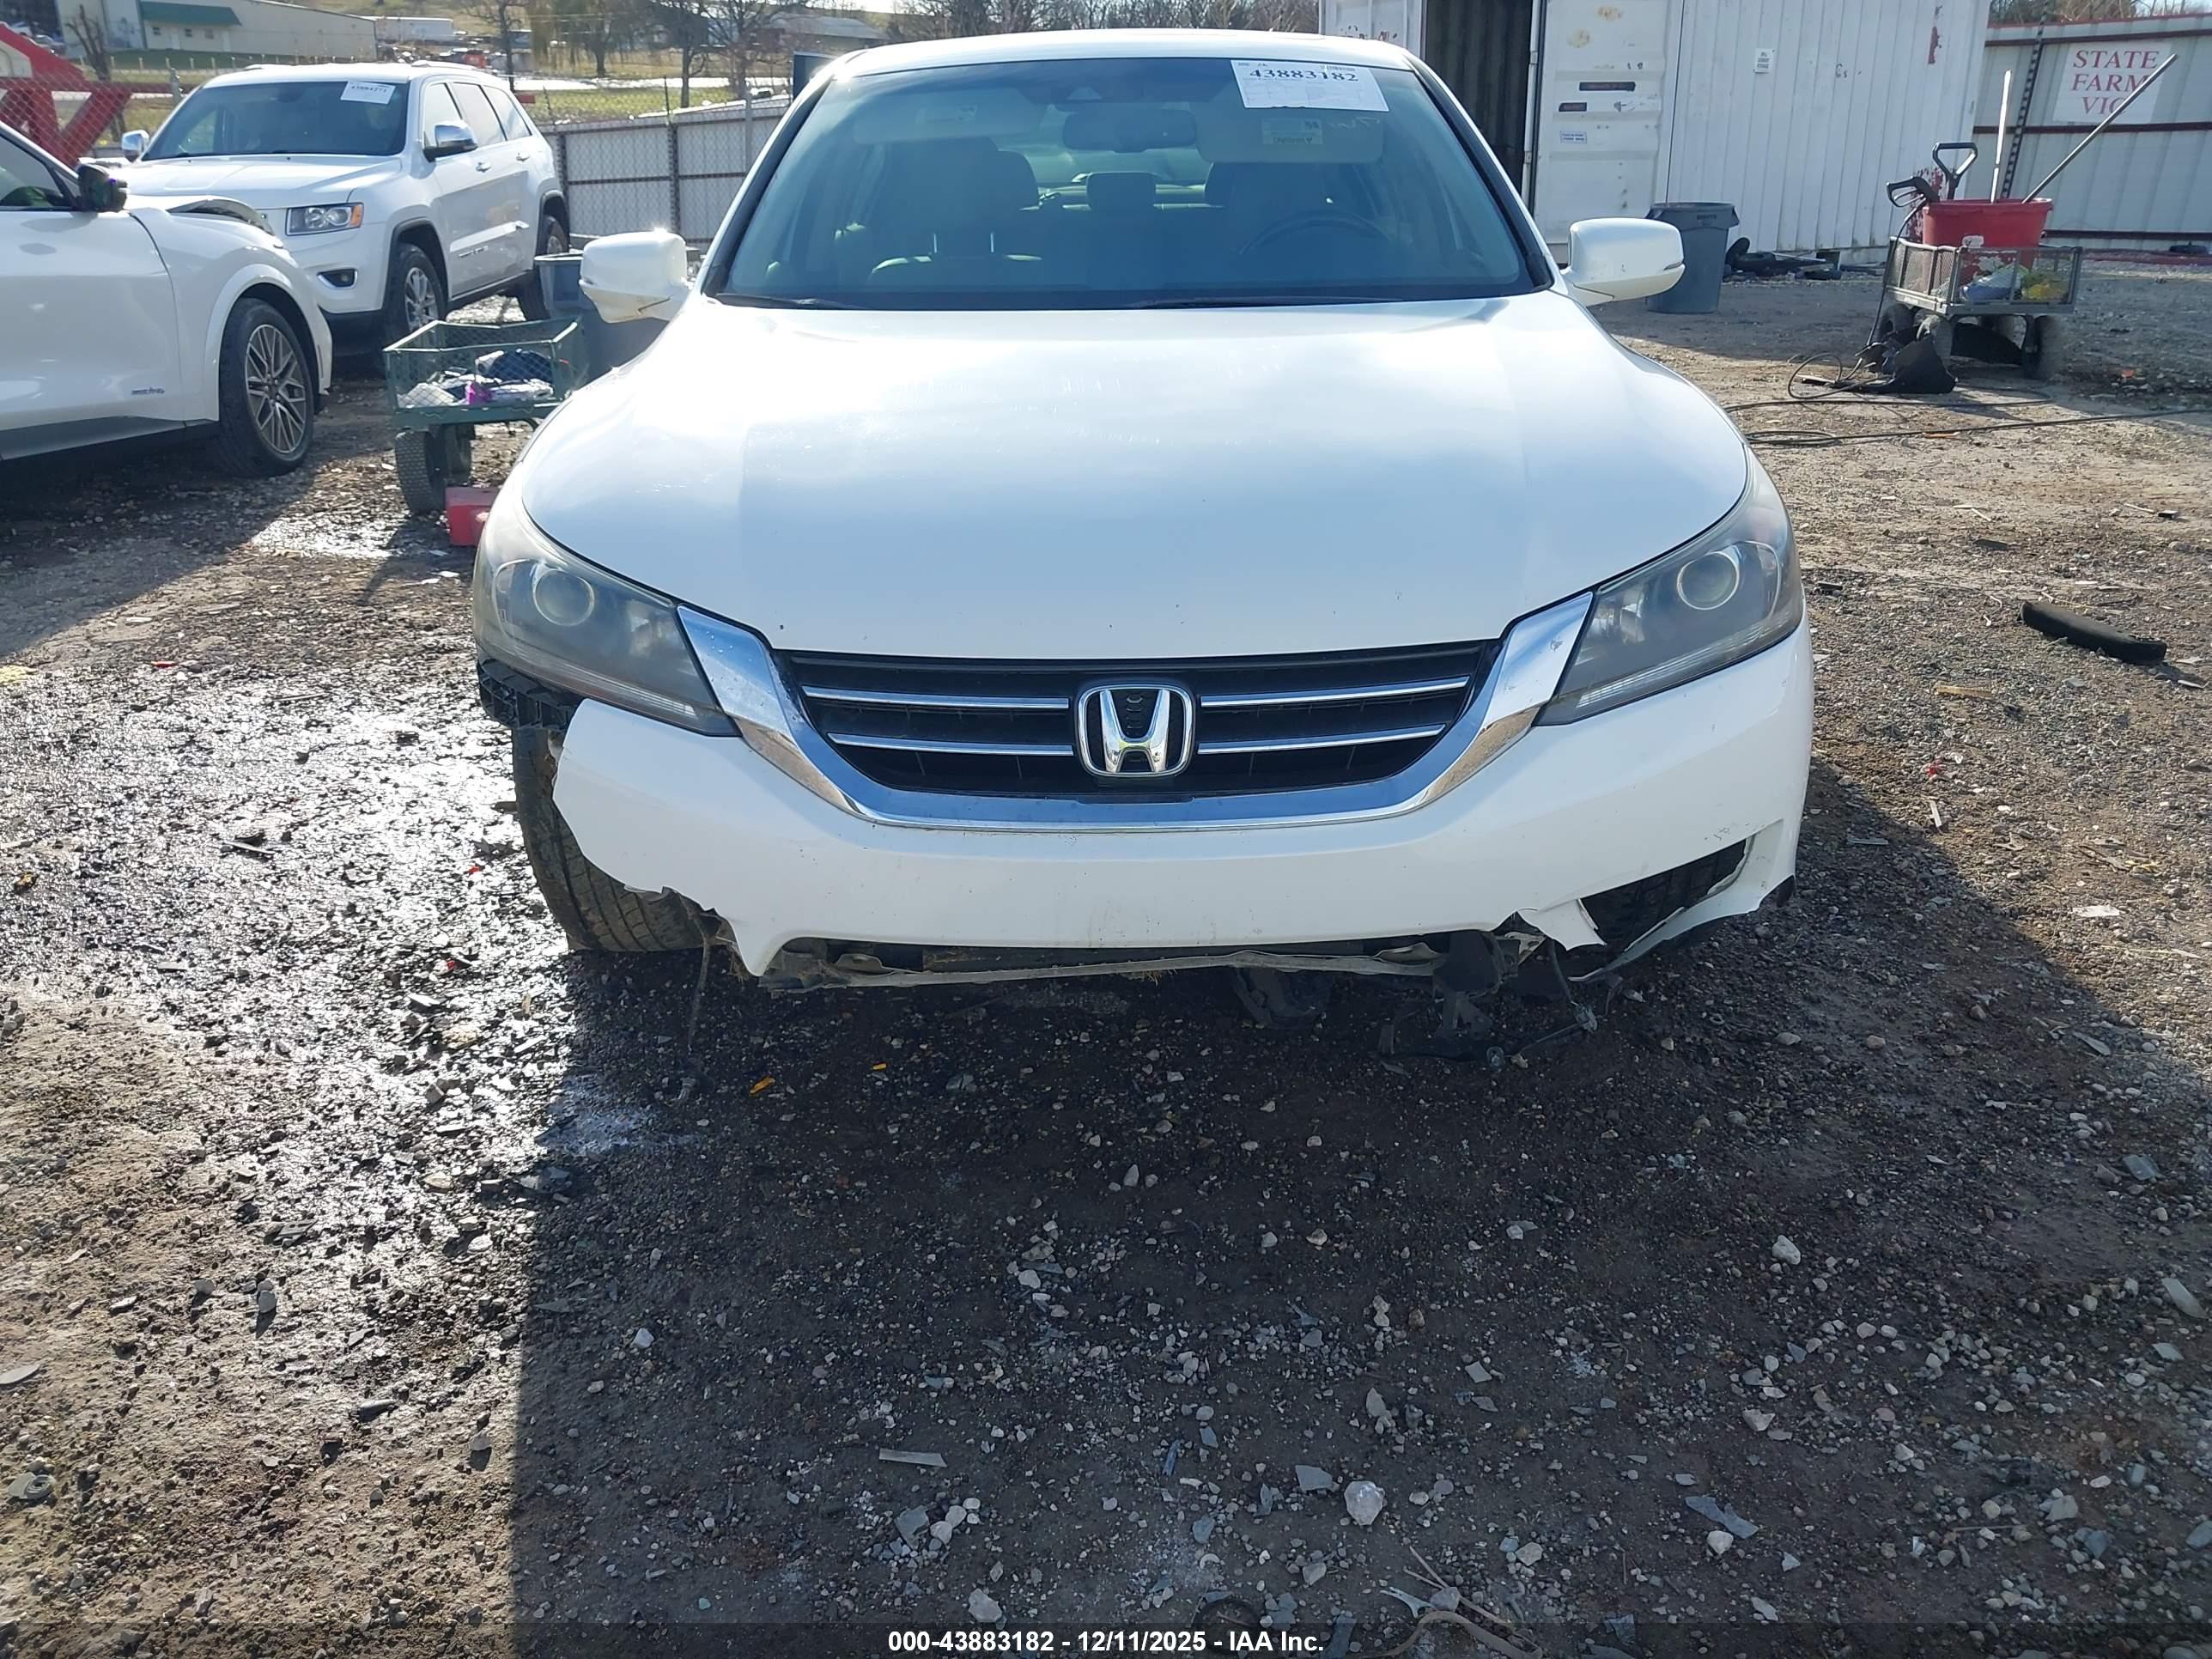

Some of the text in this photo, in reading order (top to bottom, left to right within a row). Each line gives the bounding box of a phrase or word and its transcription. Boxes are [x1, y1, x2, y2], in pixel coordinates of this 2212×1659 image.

[2073, 49, 2160, 69] STATE
[1249, 69, 1359, 82] 43883182
[2069, 73, 2151, 92] FARM
